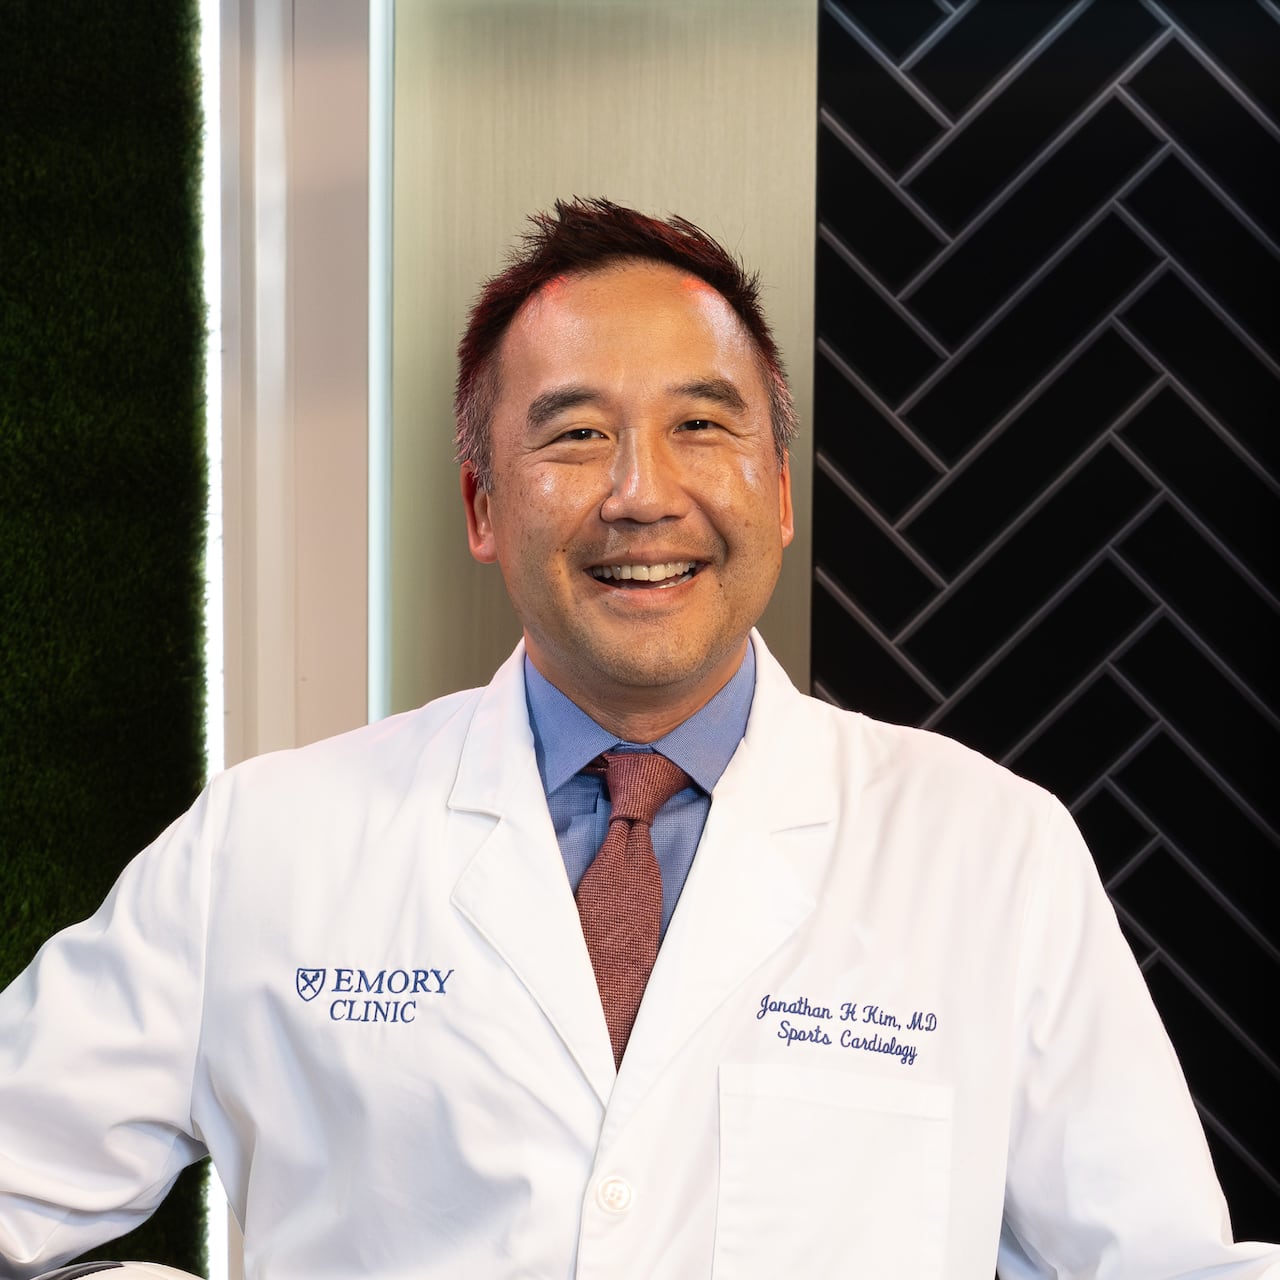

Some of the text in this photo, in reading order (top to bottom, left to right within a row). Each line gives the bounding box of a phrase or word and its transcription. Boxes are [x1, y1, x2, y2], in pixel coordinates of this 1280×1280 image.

[331, 968, 454, 994] EMORY
[329, 999, 416, 1023] CLINIC
[756, 994, 937, 1032] Jonathan H Kim, MD
[777, 1020, 918, 1066] Sports Cardiology
